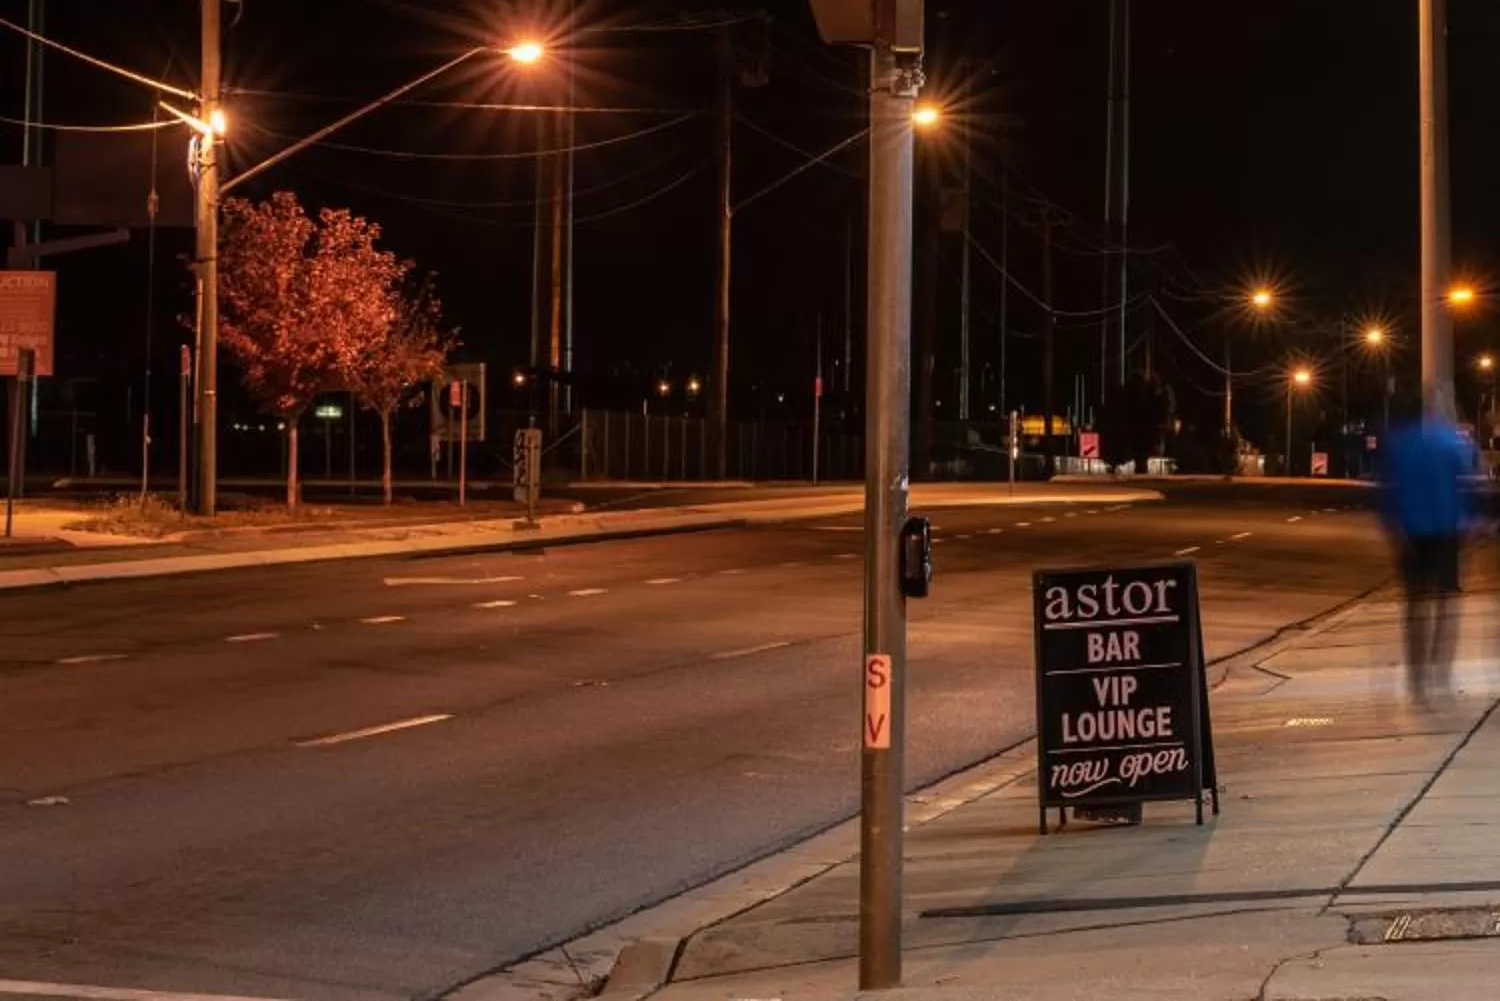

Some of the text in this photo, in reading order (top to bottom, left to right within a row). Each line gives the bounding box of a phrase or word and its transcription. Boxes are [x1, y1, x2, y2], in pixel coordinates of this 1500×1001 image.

[1044, 574, 1178, 621] astor
[1087, 630, 1141, 663] BAR
[1093, 675, 1138, 707] VIP
[1062, 706, 1173, 743] LOUNGE
[1051, 747, 1189, 789] now open
